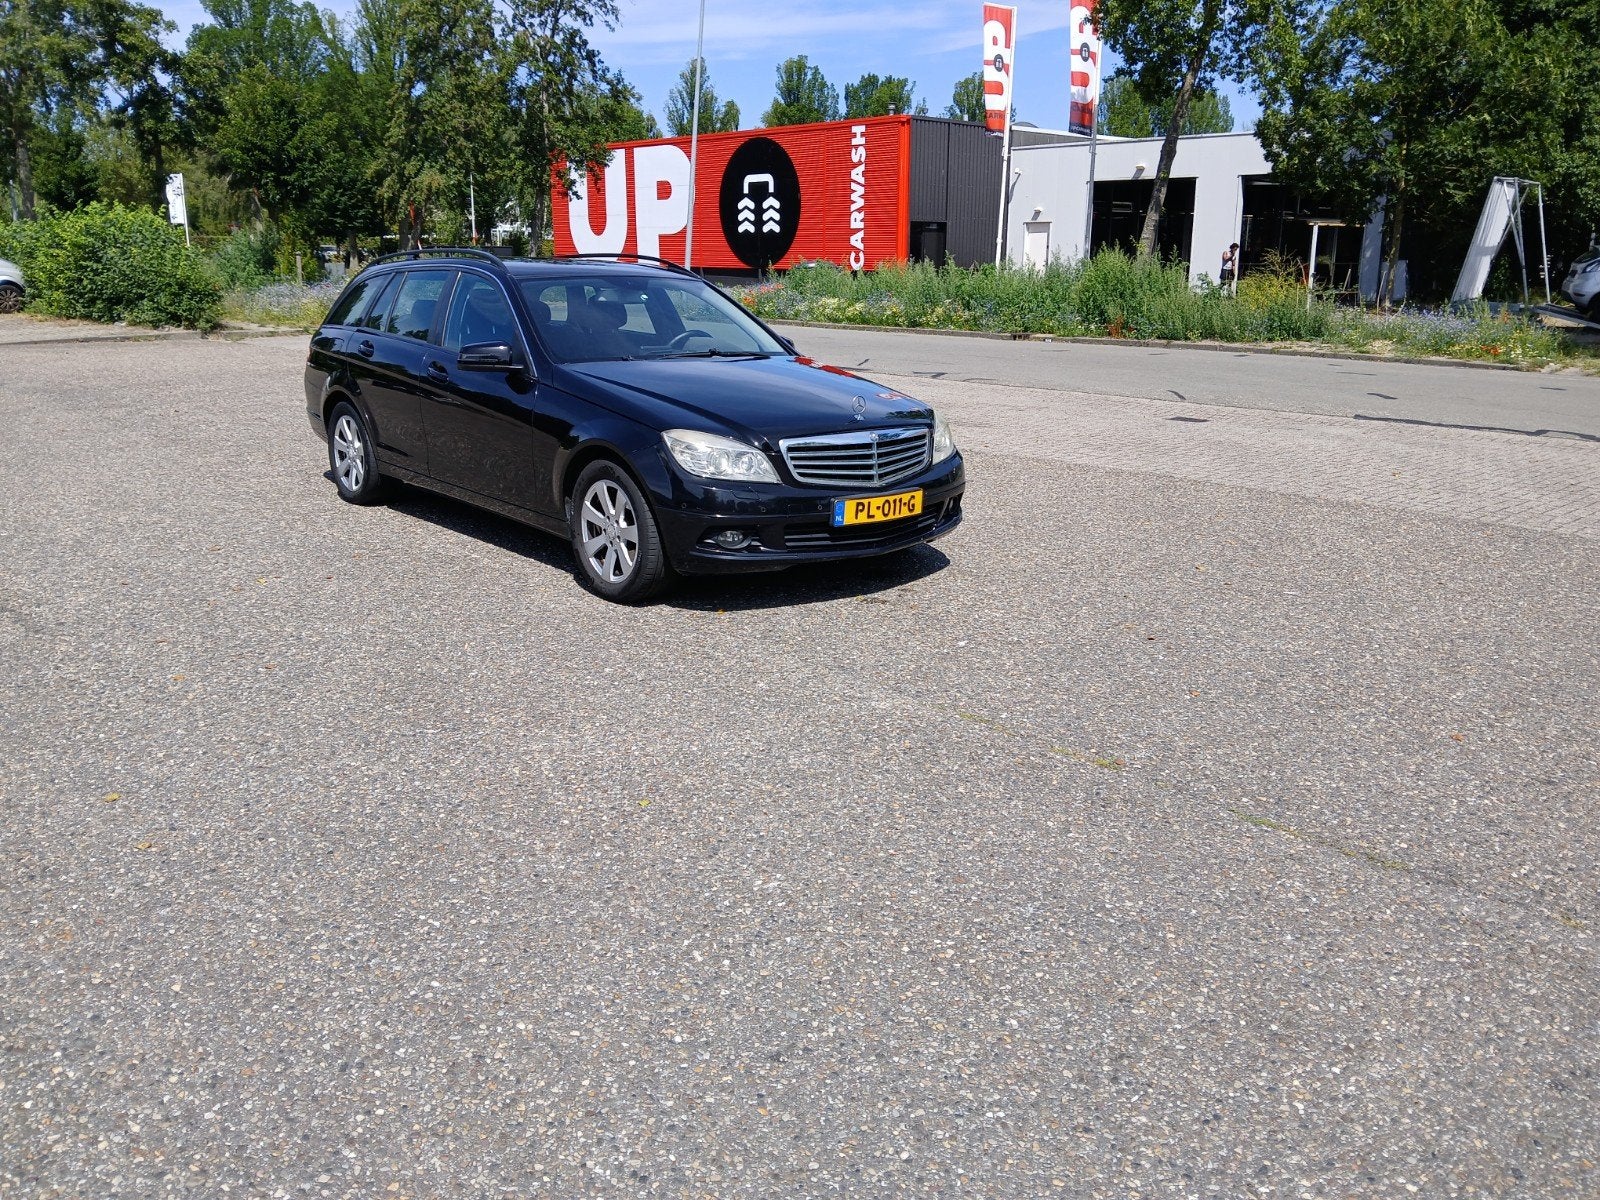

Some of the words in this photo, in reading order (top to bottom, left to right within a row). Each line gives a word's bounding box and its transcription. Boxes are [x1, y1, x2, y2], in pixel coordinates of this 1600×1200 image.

[567, 144, 696, 267] UP
[849, 125, 866, 271] CARWASH
[854, 495, 916, 520] PL-011-G
